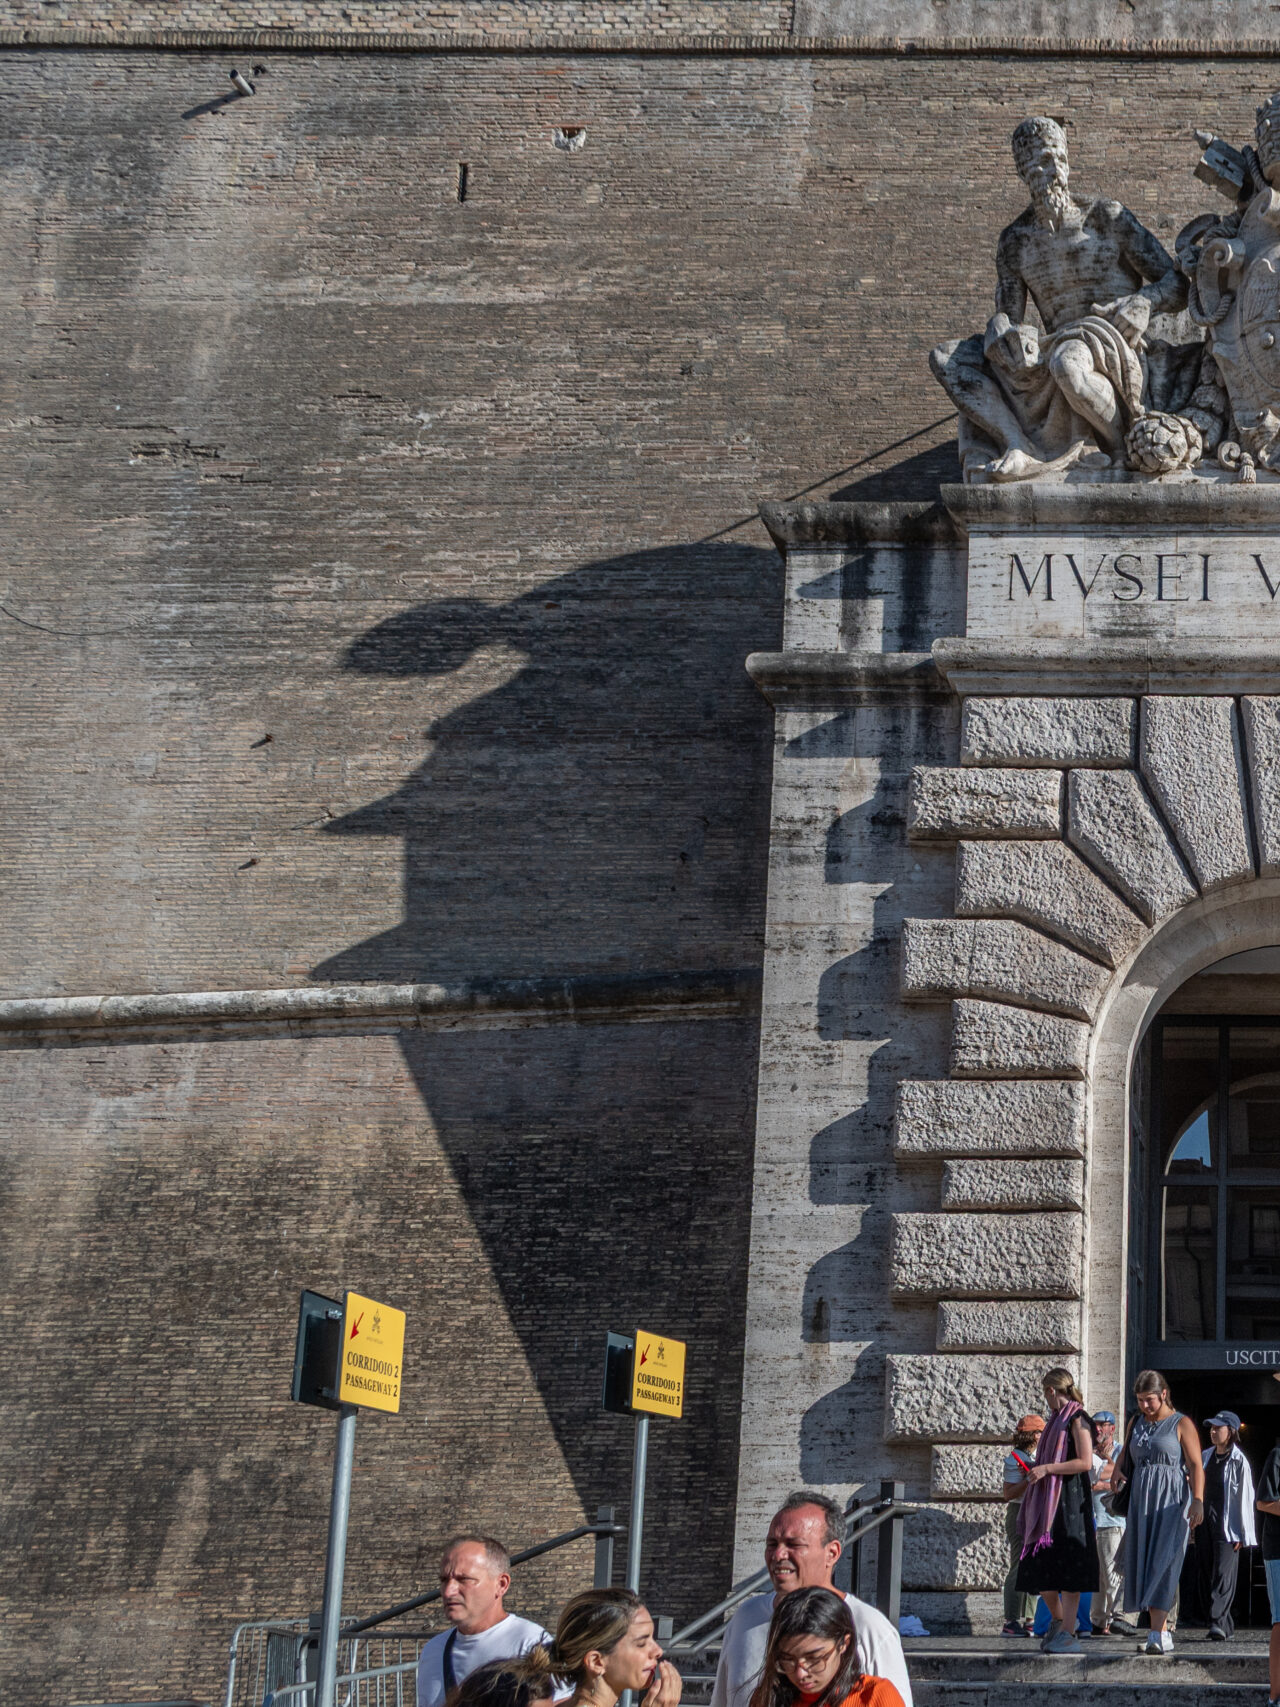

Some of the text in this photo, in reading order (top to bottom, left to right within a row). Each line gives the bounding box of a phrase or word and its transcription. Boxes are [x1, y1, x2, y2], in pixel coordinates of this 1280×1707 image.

[1008, 553, 1212, 602] MVSEI
[346, 1351, 399, 1378] CORRIDOIO 2
[345, 1373, 398, 1397] PASSAGEWAY 2
[637, 1372, 681, 1392] CORRIDOIO 3
[636, 1388, 681, 1406] PASSAGEWAY 3
